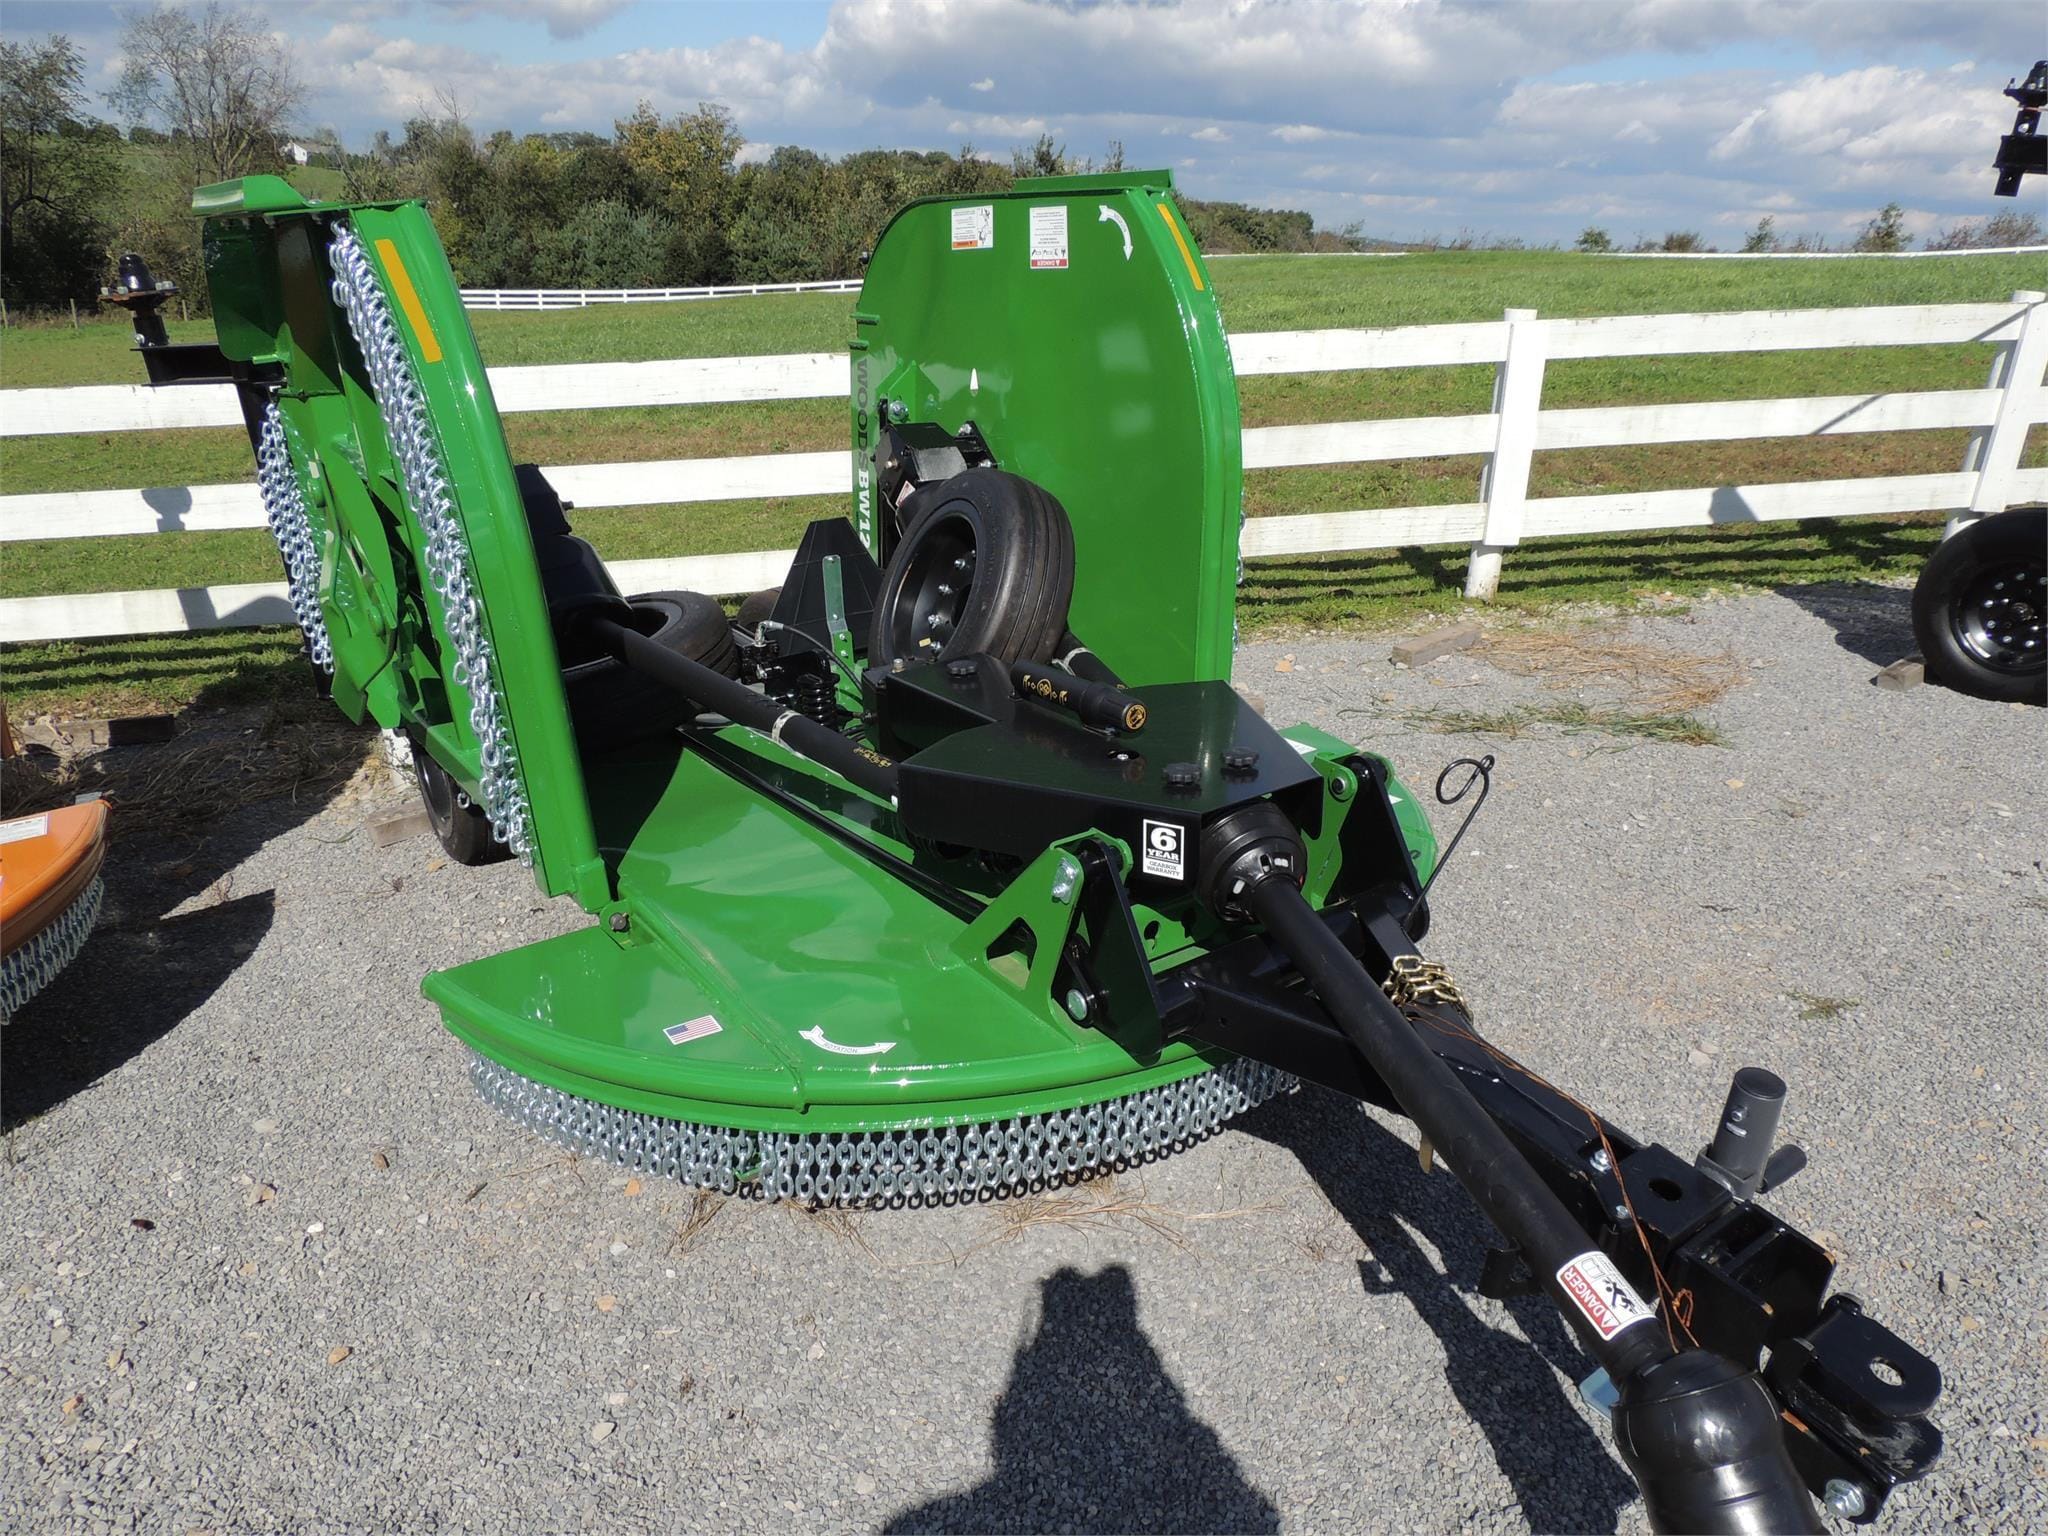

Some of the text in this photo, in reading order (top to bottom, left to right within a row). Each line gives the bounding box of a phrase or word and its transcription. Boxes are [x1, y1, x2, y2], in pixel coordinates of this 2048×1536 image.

[1037, 259, 1057, 267] DANGER
[857, 358, 871, 549] WOODS BW12
[1151, 827, 1177, 852] 6
[1147, 848, 1179, 861] YEAR
[1146, 865, 1181, 877] WARRANTY
[1149, 860, 1178, 871] GEARBOX
[823, 1042, 858, 1054] ROTATION
[1564, 1267, 1607, 1317] DANGER
